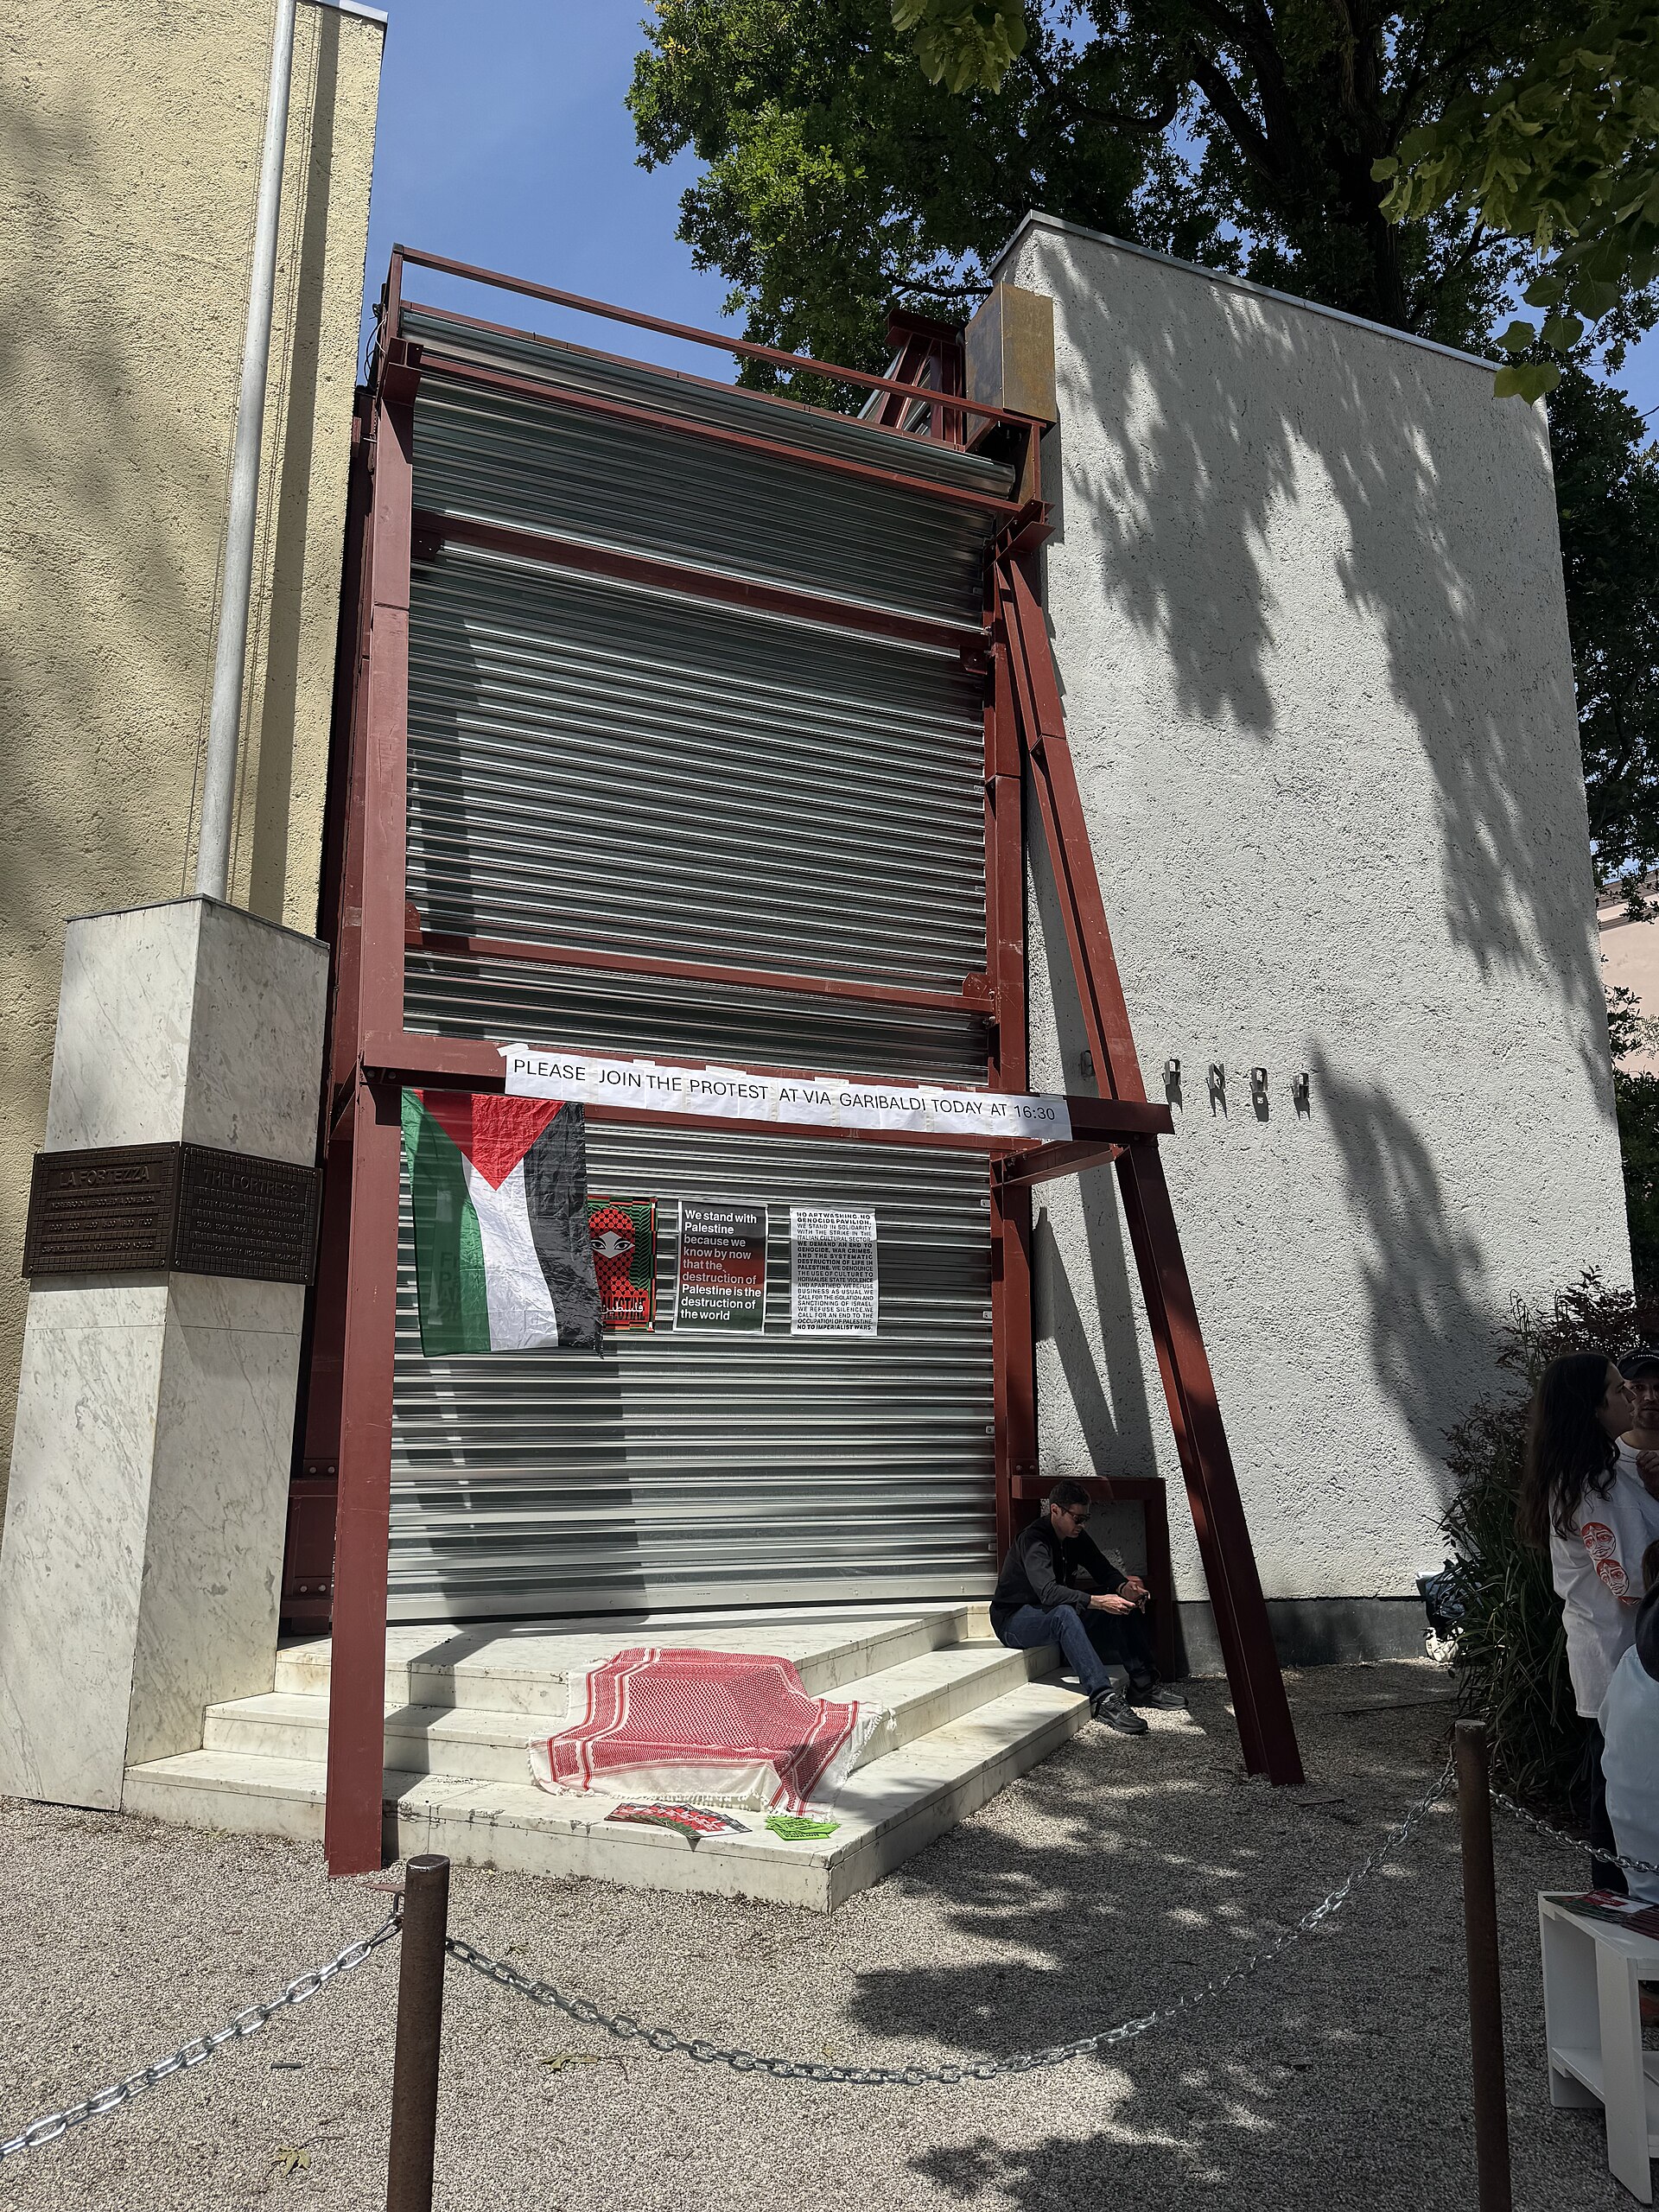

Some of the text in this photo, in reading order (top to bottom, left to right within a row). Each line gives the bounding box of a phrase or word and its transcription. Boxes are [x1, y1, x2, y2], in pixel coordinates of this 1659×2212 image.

[514, 1059, 1055, 1121] PLEASE JOIN THE PROTEST AT VIA GARIBALDI TODAY AT 16:30
[60, 1166, 150, 1187] LA FORTEZZA
[203, 1168, 299, 1198] THE FORTRESS
[685, 1210, 757, 1224] We stand with
[685, 1222, 734, 1234] Palestine
[684, 1234, 729, 1246] because
[683, 1247, 712, 1257] know
[715, 1249, 727, 1260] by
[683, 1259, 722, 1270] that the
[683, 1272, 757, 1284] destruction of
[683, 1284, 761, 1297] Palestine is the
[601, 1301, 644, 1314] فلسطين
[681, 1296, 756, 1309] destruction of
[681, 1309, 729, 1320] the world
